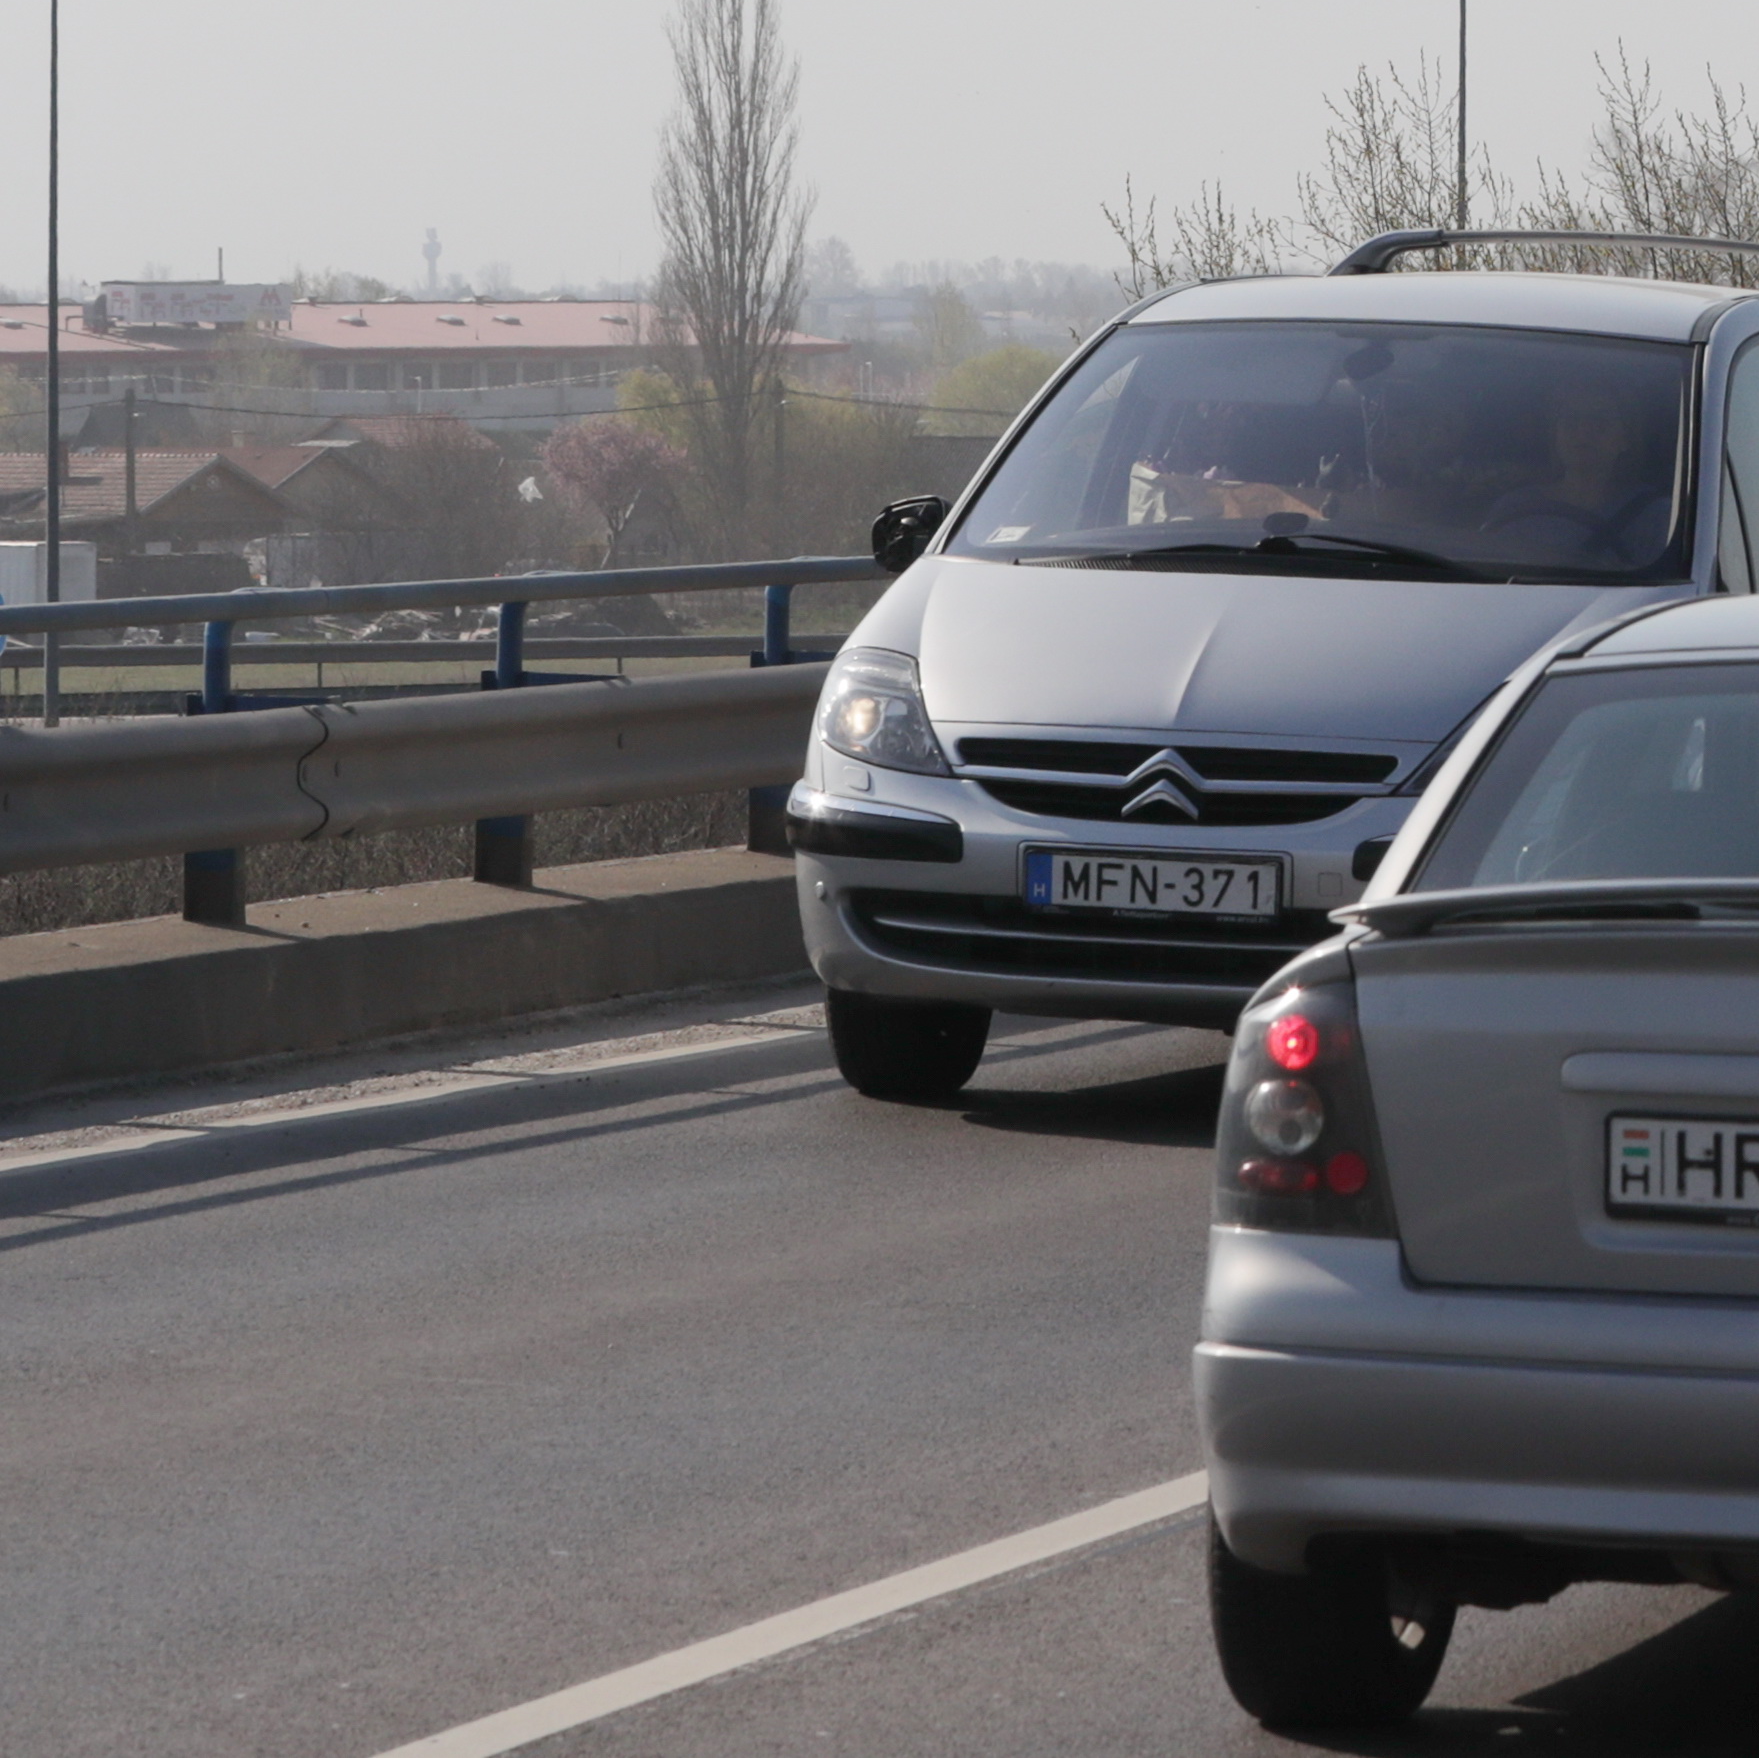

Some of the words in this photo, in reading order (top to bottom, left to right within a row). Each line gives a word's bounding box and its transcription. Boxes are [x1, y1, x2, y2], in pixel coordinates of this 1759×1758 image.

[1033, 883, 1046, 898] H
[1062, 861, 1260, 910] MFN-371
[1621, 1164, 1650, 1195] H
